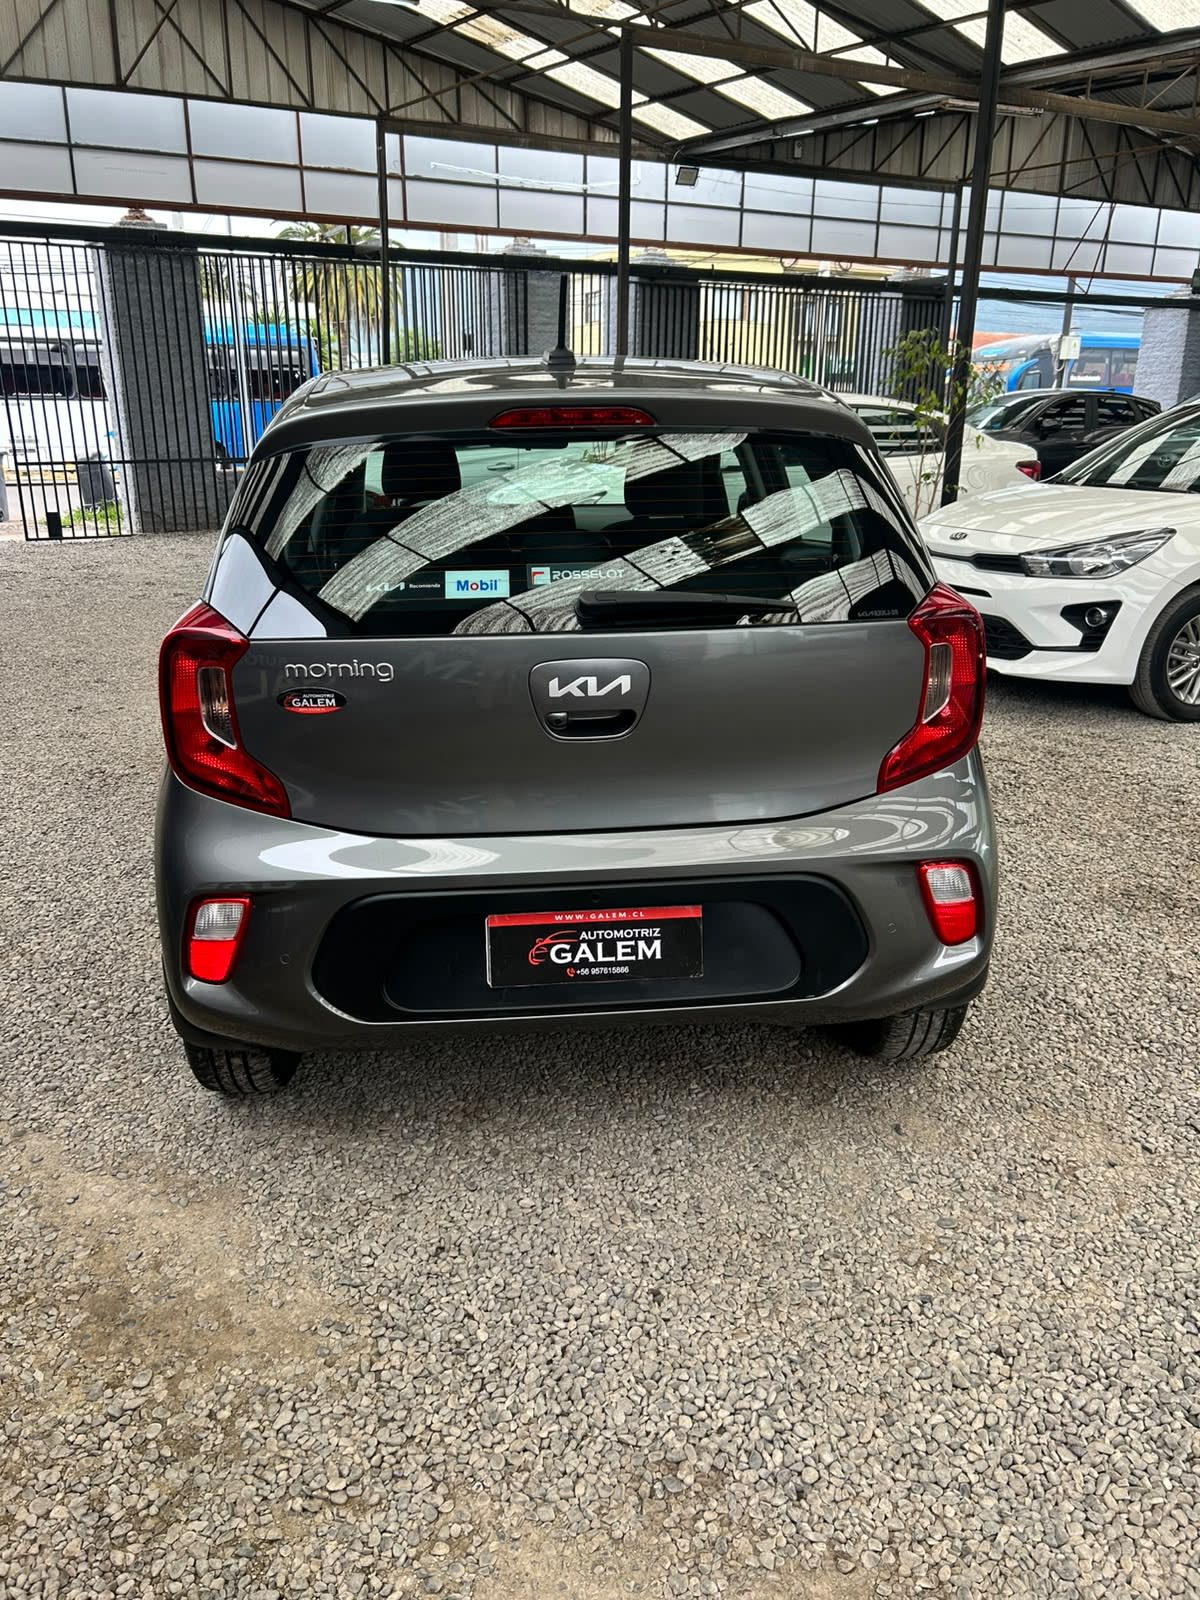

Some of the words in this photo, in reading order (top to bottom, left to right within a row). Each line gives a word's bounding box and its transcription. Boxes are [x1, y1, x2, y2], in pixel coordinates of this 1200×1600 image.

[552, 569, 625, 580] ROSSELOT
[456, 579, 498, 593] Mobil
[284, 659, 394, 682] morning
[548, 674, 631, 698] KIA
[291, 698, 337, 707] GALEM
[554, 911, 645, 921] WWW.GALEM.CL
[579, 927, 661, 941] AUTOMOTRIZ
[549, 938, 662, 965] GALEM
